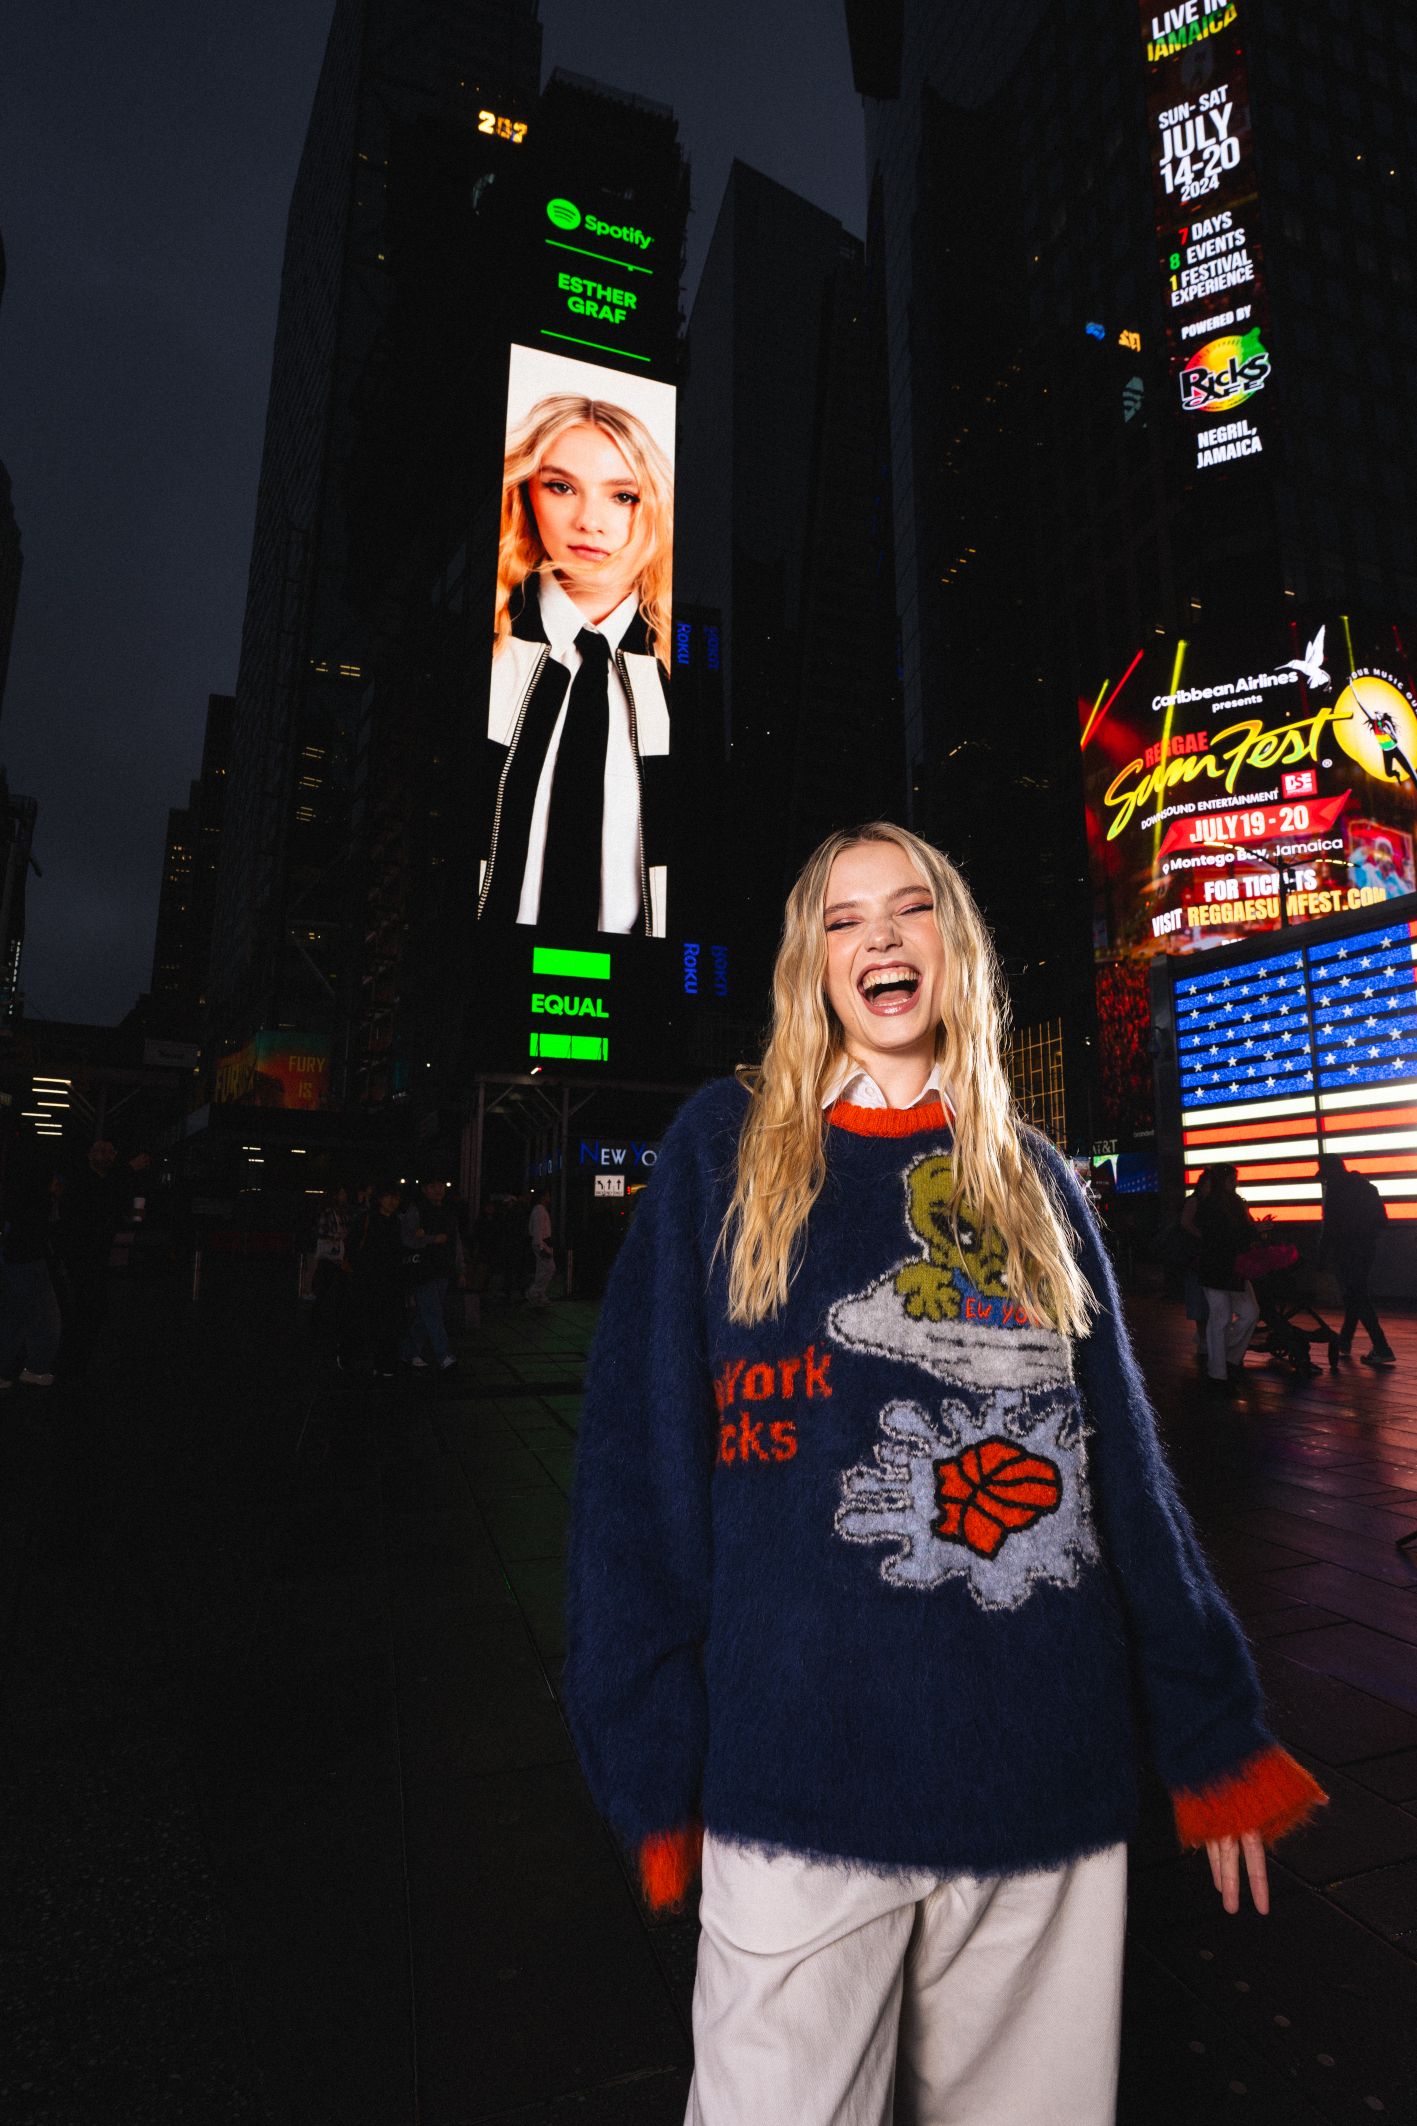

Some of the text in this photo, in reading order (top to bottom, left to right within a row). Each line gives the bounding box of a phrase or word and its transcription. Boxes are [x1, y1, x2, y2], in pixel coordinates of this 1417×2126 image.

[1152, 0, 1199, 40] LIVE
[1158, 84, 1229, 129] SUN- SAT
[1159, 102, 1233, 167] JULY
[1160, 136, 1240, 194] 14-20
[1180, 173, 1220, 202] 2024
[585, 214, 652, 249] Spotify
[1178, 211, 1233, 246] 7 DAYS
[1169, 228, 1246, 271] 8 EVENTS
[1169, 249, 1253, 292] 1 FESTIVAL
[1171, 263, 1255, 307] EXPERIENCE
[558, 272, 637, 310] ESTHER
[567, 296, 627, 324] GRAF
[1181, 304, 1252, 340] POWERED BY
[1180, 352, 1271, 401] Ricks
[1197, 419, 1258, 449] NEGRIL,
[1197, 436, 1263, 469] JAMAICA
[1152, 671, 1299, 711] Caribbean Airlines
[1372, 668, 1404, 690] MUSIC
[1211, 694, 1263, 713] presents
[1145, 731, 1209, 768] REGGAE
[1141, 789, 1279, 830] DOWNSOUND ENTERTAINMENT
[1189, 814, 1240, 843] JULY
[1240, 811, 1266, 837] 19
[1279, 804, 1311, 832] 20
[1170, 851, 1235, 871] Montego
[1273, 838, 1344, 857] Jamaica
[1204, 878, 1240, 903] FOR
[1152, 908, 1183, 938] VISIT
[531, 993, 610, 1018] EQUAL
[288, 1055, 327, 1073] FURY
[579, 1140, 627, 1166] NEW
